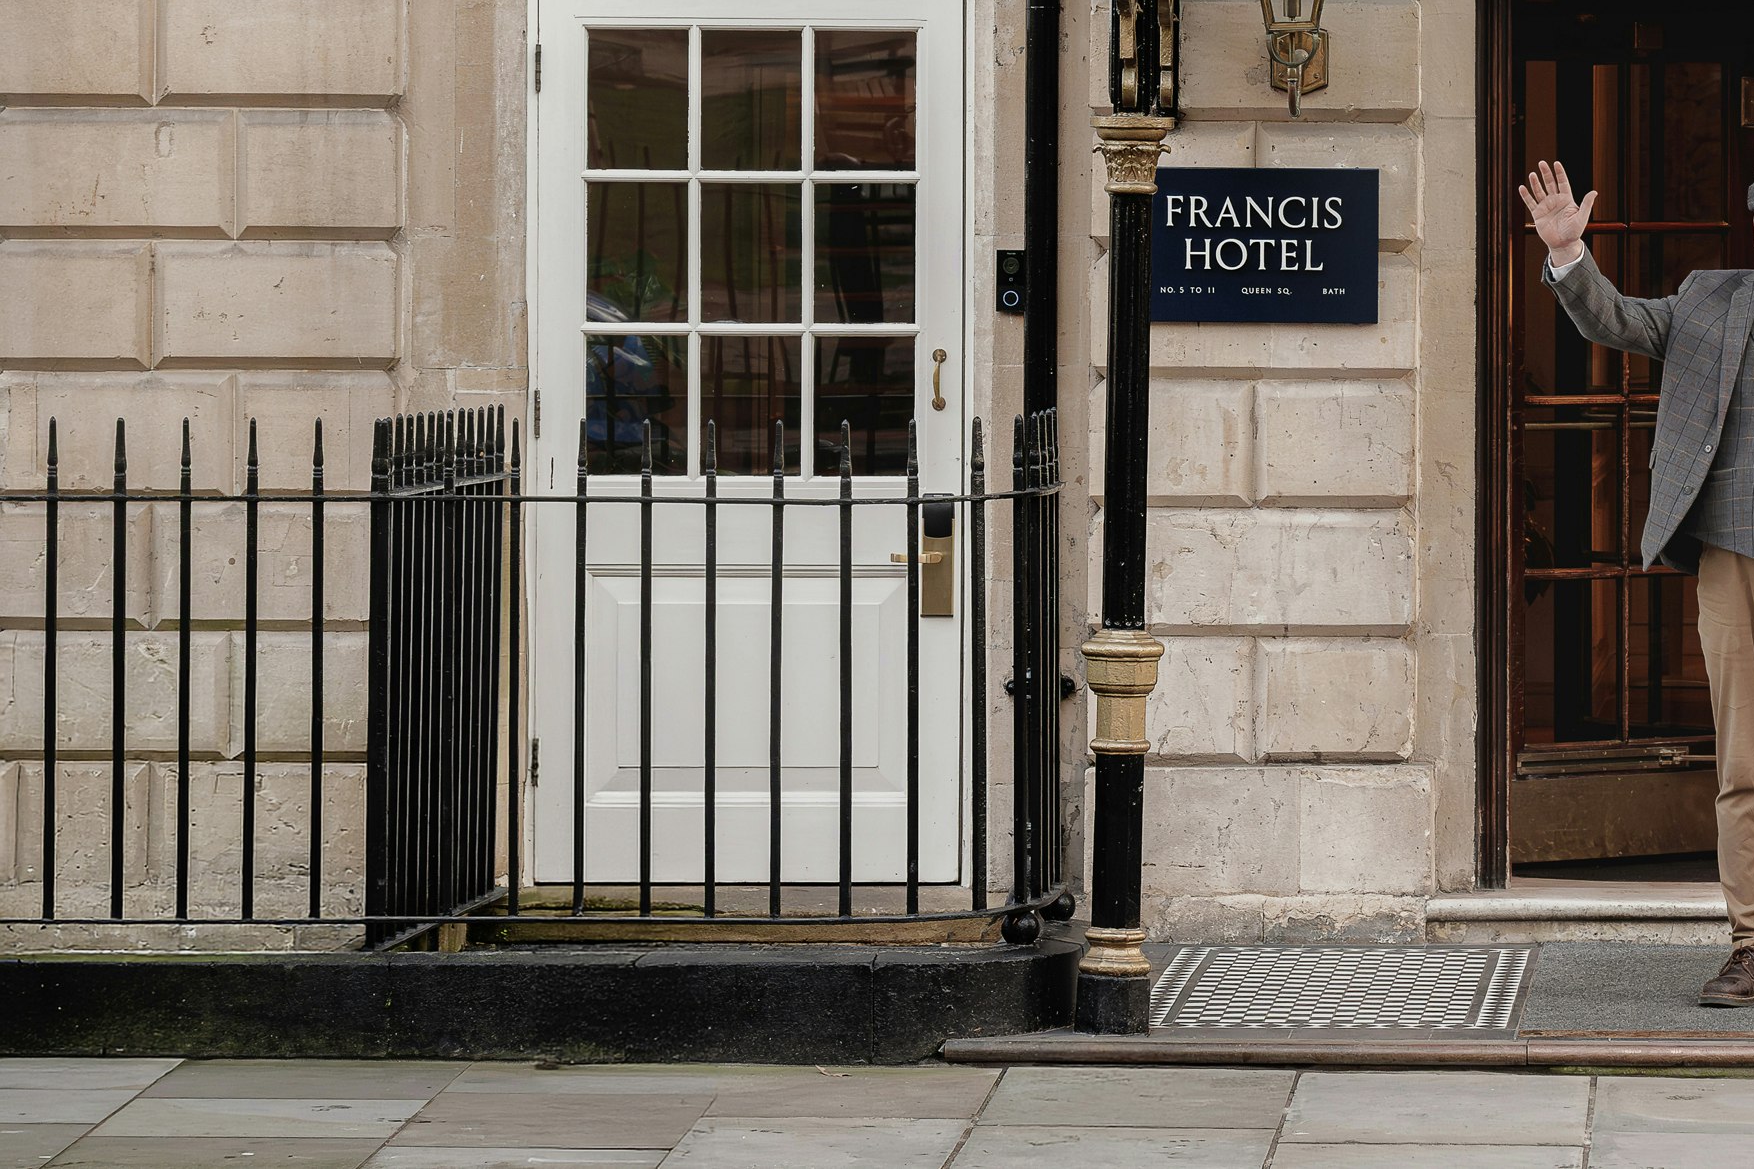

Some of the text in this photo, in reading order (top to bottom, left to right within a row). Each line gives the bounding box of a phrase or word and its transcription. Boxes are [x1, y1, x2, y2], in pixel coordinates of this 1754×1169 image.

[1166, 195, 1343, 229] FRANCIS
[1184, 238, 1324, 271] HOTEL
[1160, 286, 1176, 294] NO.
[1179, 286, 1185, 294] 5
[1190, 286, 1203, 294] TO
[1241, 287, 1272, 295] QUEEN
[1277, 287, 1293, 296] SQ.
